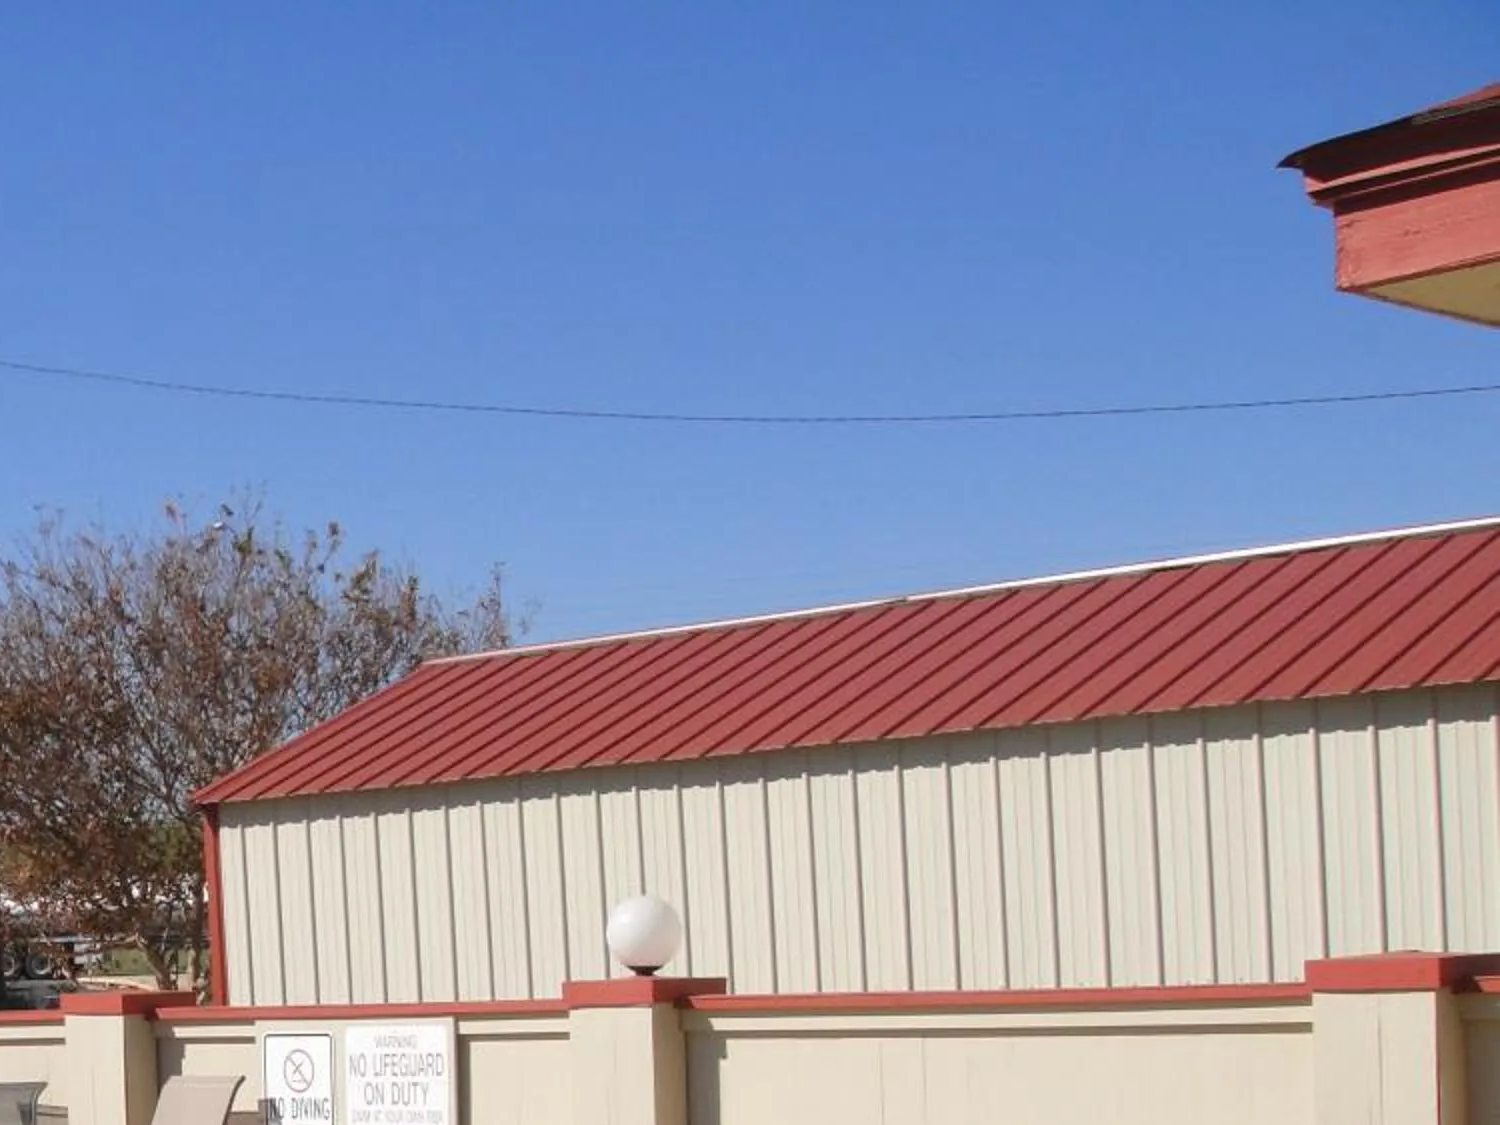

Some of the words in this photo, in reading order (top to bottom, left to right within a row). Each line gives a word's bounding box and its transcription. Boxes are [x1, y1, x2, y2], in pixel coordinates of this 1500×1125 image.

[349, 1052, 368, 1078] NO
[373, 1052, 445, 1077] LIFEGUARD
[364, 1082, 386, 1106] ON
[391, 1081, 431, 1106] DUTY
[268, 1096, 286, 1120] NO
[291, 1097, 331, 1120] DIVING
